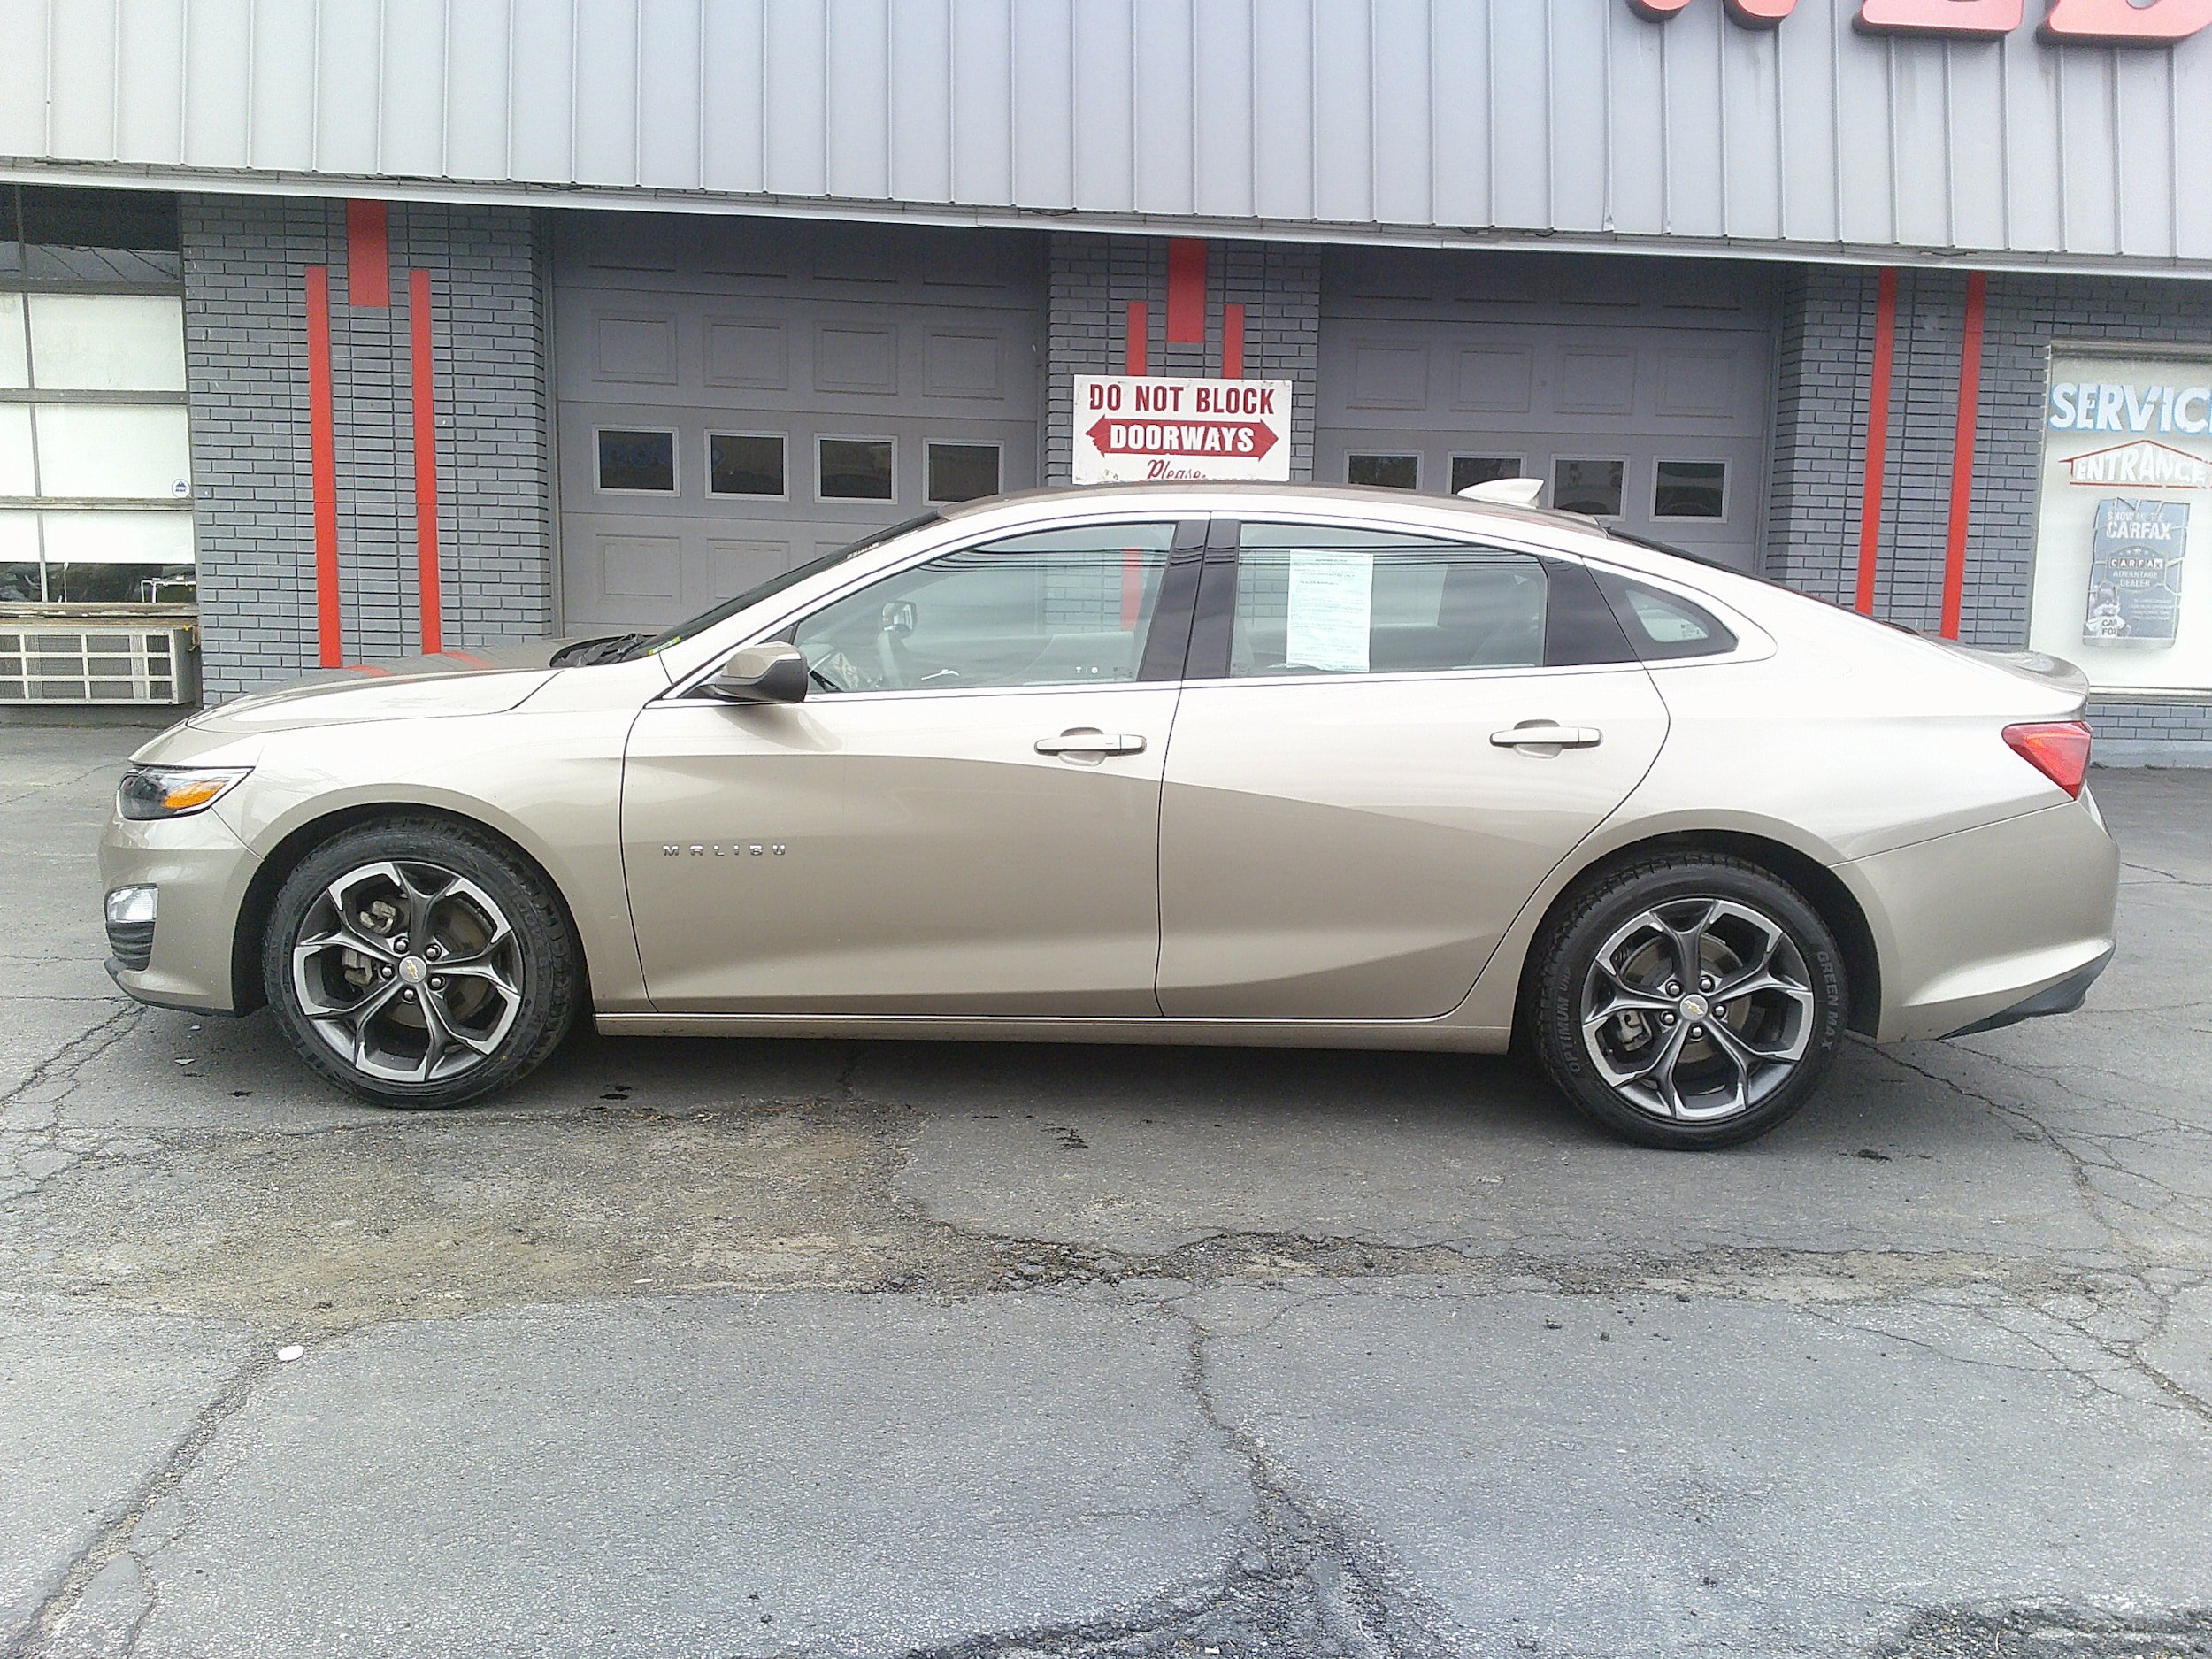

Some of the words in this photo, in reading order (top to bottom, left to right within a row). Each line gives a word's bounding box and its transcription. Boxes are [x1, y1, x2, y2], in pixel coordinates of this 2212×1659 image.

[1089, 383, 1122, 411] DO
[1135, 385, 1184, 412] NOT
[1196, 387, 1275, 415] BLOCK
[2048, 381, 2212, 434] SERVIC
[1110, 424, 1255, 453] DOORWAYS
[2076, 444, 2207, 483] ENTRANCE
[2106, 520, 2172, 540] CARFAX
[2110, 557, 2163, 568] CARFAX
[663, 845, 786, 856] MALIBU
[1816, 951, 1839, 1006] GREEN
